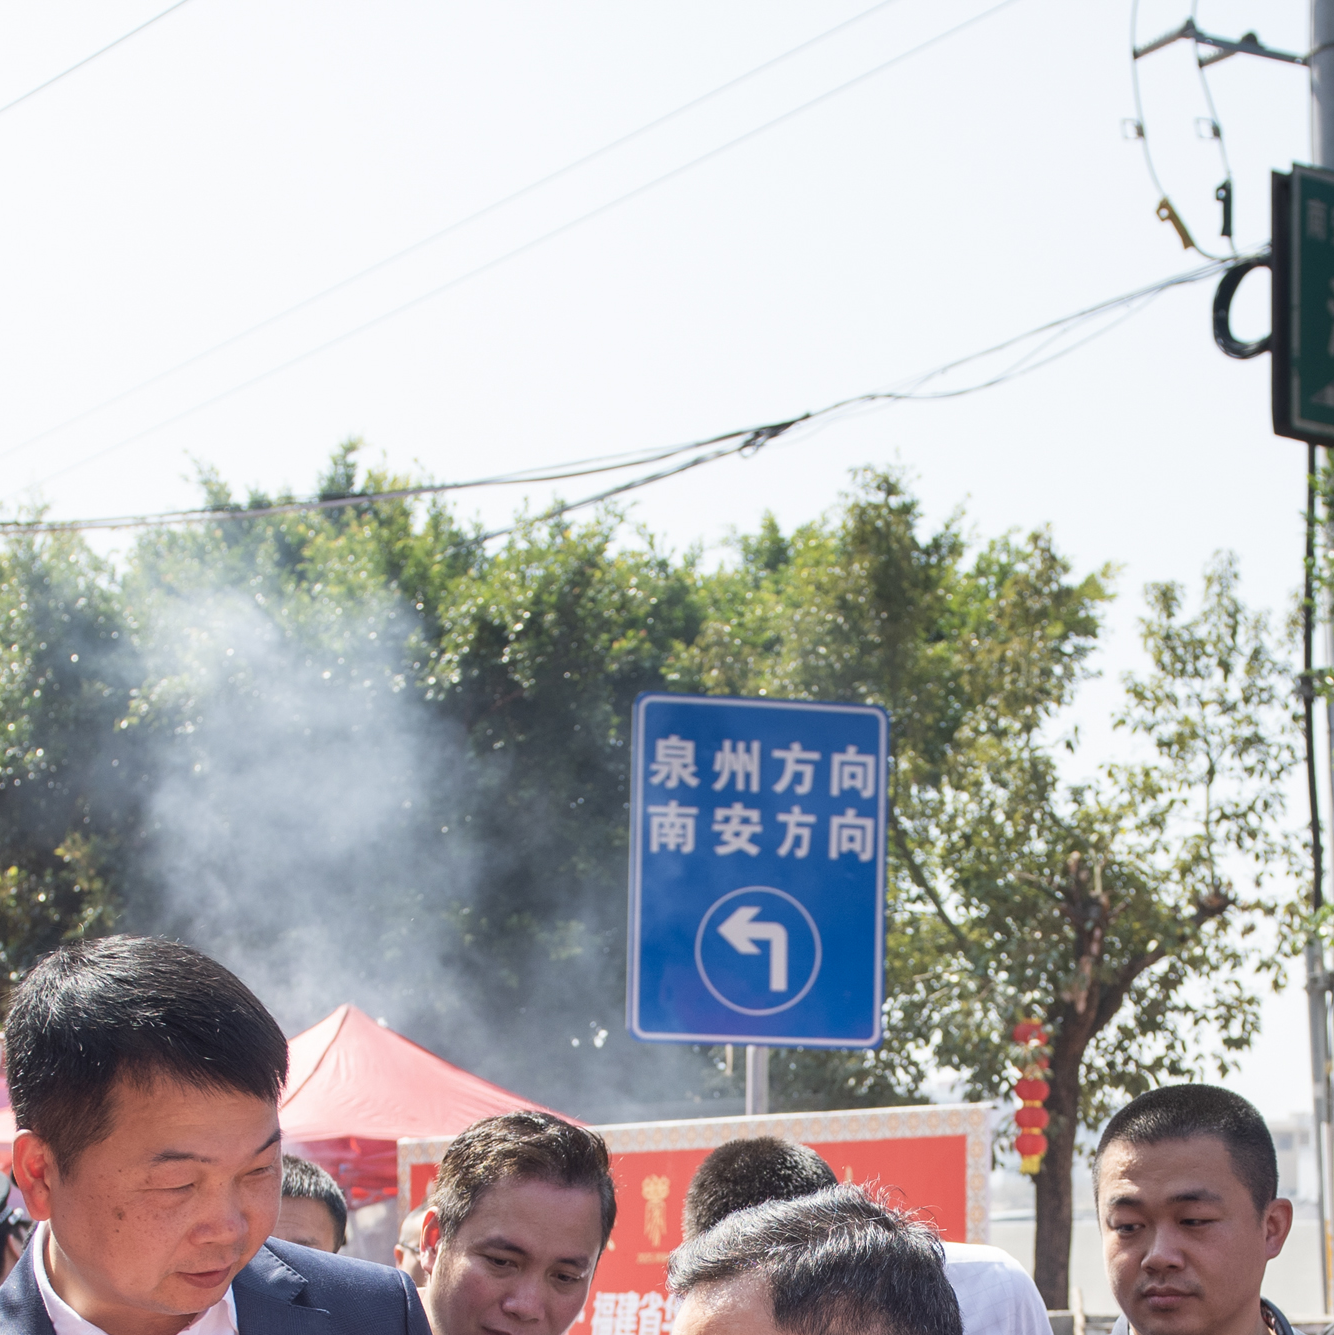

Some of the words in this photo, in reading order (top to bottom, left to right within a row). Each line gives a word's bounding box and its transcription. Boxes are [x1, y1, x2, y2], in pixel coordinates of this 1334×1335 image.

[649, 734, 877, 799] 泉州方向
[647, 800, 875, 862] 南安方向
